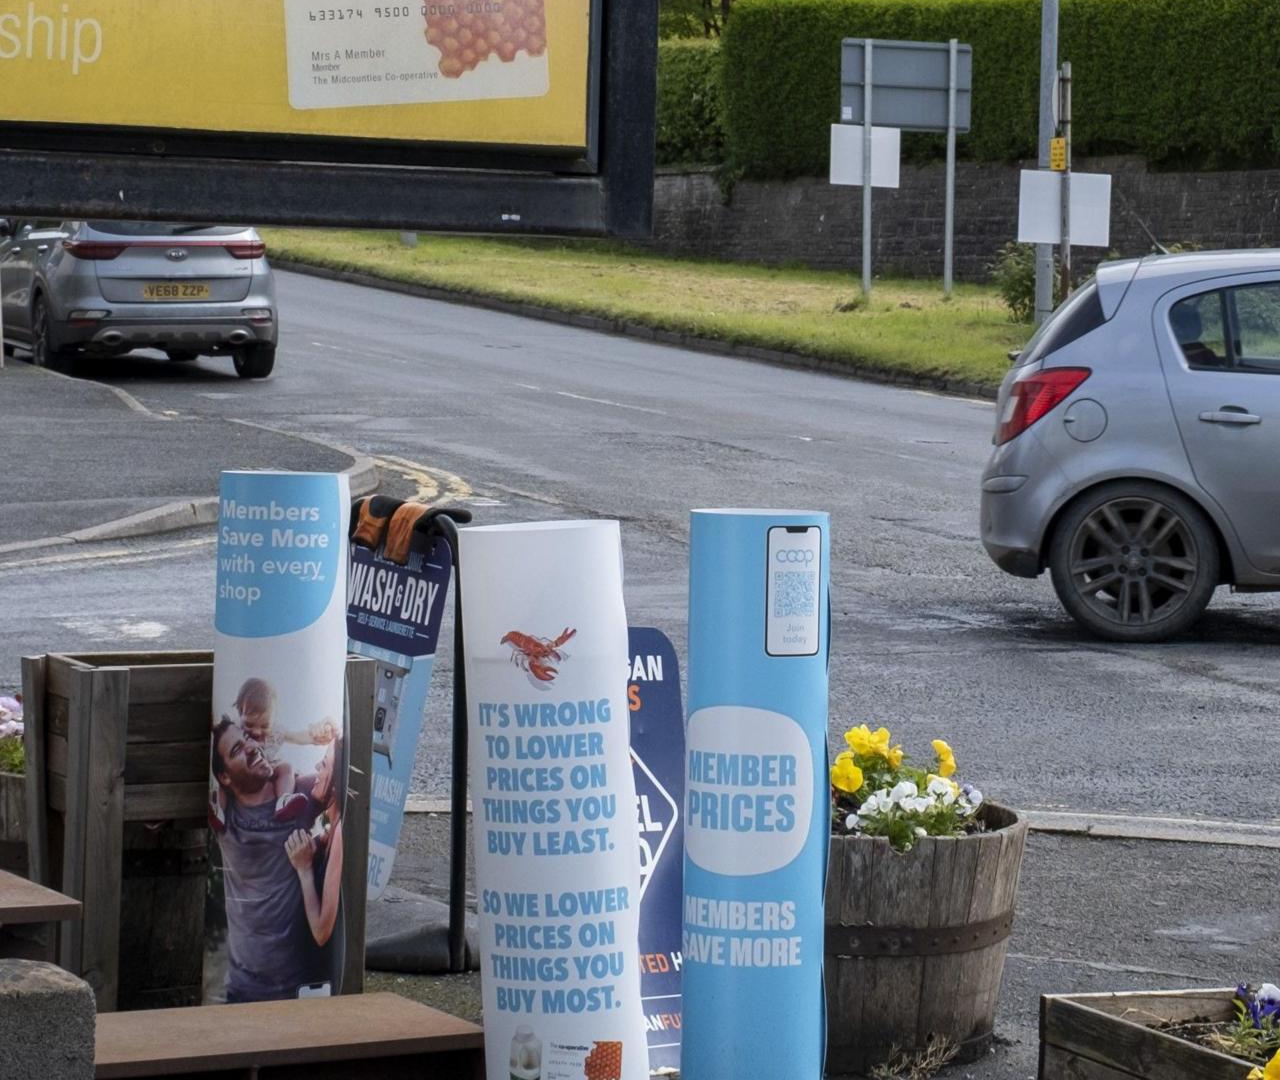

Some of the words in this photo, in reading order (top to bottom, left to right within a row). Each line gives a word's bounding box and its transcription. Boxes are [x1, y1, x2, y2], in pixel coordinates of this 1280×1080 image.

[309, 9, 363, 21] 633174
[374, 6, 410, 18] 9500
[311, 51, 331, 61] Mrs
[334, 50, 342, 60] A
[345, 48, 385, 59] Member
[311, 63, 340, 72] Member
[312, 75, 328, 85] The
[331, 73, 382, 84] Midcounties
[385, 71, 439, 83] Co-operative
[182, 284, 205, 297] ZZP
[222, 499, 320, 521] Members
[222, 526, 265, 547] Save
[271, 528, 329, 548] More
[220, 553, 255, 573] with
[262, 559, 323, 581] every
[219, 579, 261, 606] shop
[783, 634, 807, 646] today
[786, 623, 805, 633] Join
[478, 703, 510, 728] IT'S
[514, 698, 611, 728] WRONG
[485, 735, 510, 760] TO
[516, 732, 604, 760] LOWER
[486, 766, 564, 792] PRICES
[570, 763, 607, 790] ON
[688, 750, 797, 787] MEMBER
[482, 798, 561, 824] THINGS
[565, 794, 616, 823] YOU
[688, 789, 796, 832] PRICES
[487, 830, 526, 856] BUY
[533, 827, 615, 856] LEAST.
[483, 889, 501, 915] SO
[504, 892, 539, 917] WE
[545, 886, 629, 917] LOWER
[685, 895, 796, 931] MEMBERS
[494, 923, 572, 950] PRICES
[579, 921, 615, 948] ON
[682, 929, 725, 966] SAVE
[730, 936, 802, 967] MORE
[491, 954, 569, 982] THINGS
[573, 951, 624, 980] YOU
[497, 987, 536, 1012] BUY
[542, 985, 621, 1014] MOST.
